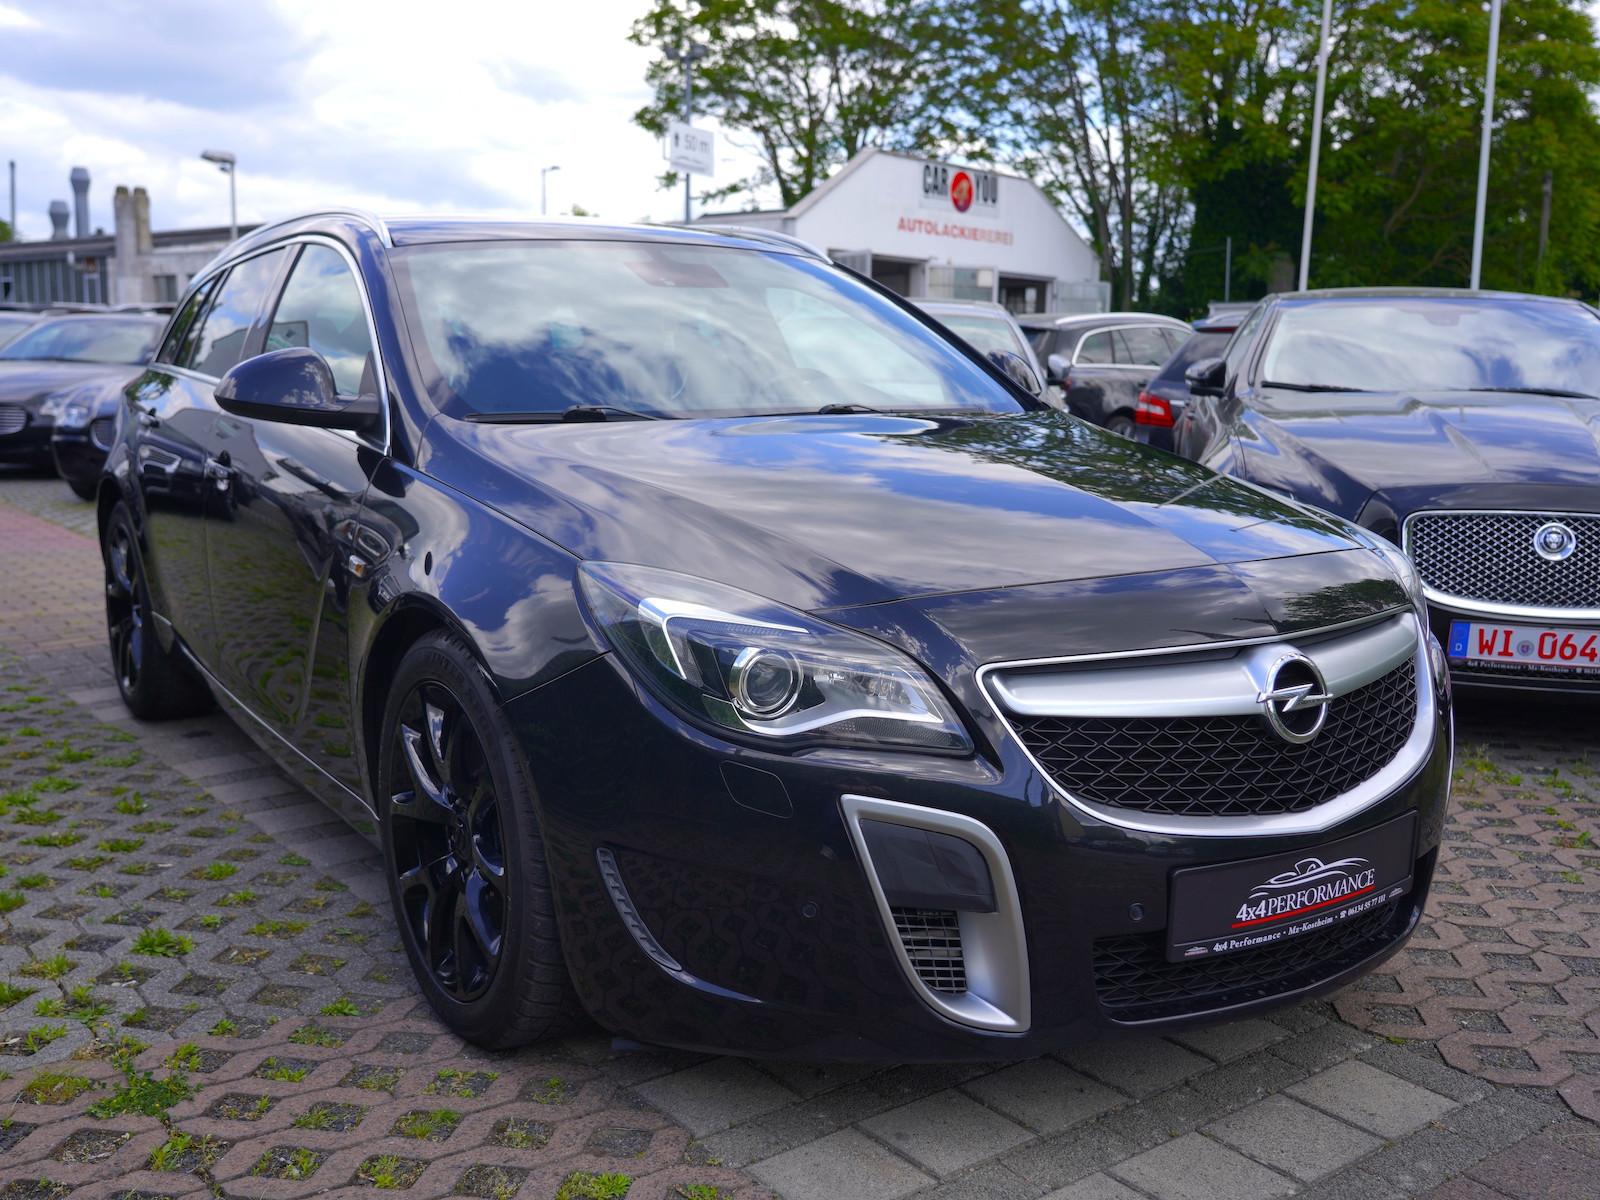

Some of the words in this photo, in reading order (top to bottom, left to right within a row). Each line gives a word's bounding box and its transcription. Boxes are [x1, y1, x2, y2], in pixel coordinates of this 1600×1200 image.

[923, 164, 949, 197] CAR
[974, 171, 998, 204] YOU
[898, 217, 1014, 246] AUTOLACKIEREREI
[1455, 643, 1463, 652] D
[1478, 627, 1514, 657] WI
[1480, 661, 1521, 670] Performance
[1213, 942, 1228, 952] 4x4
[1229, 931, 1281, 949] Performance
[1288, 916, 1334, 936] Mz-Kostheim
